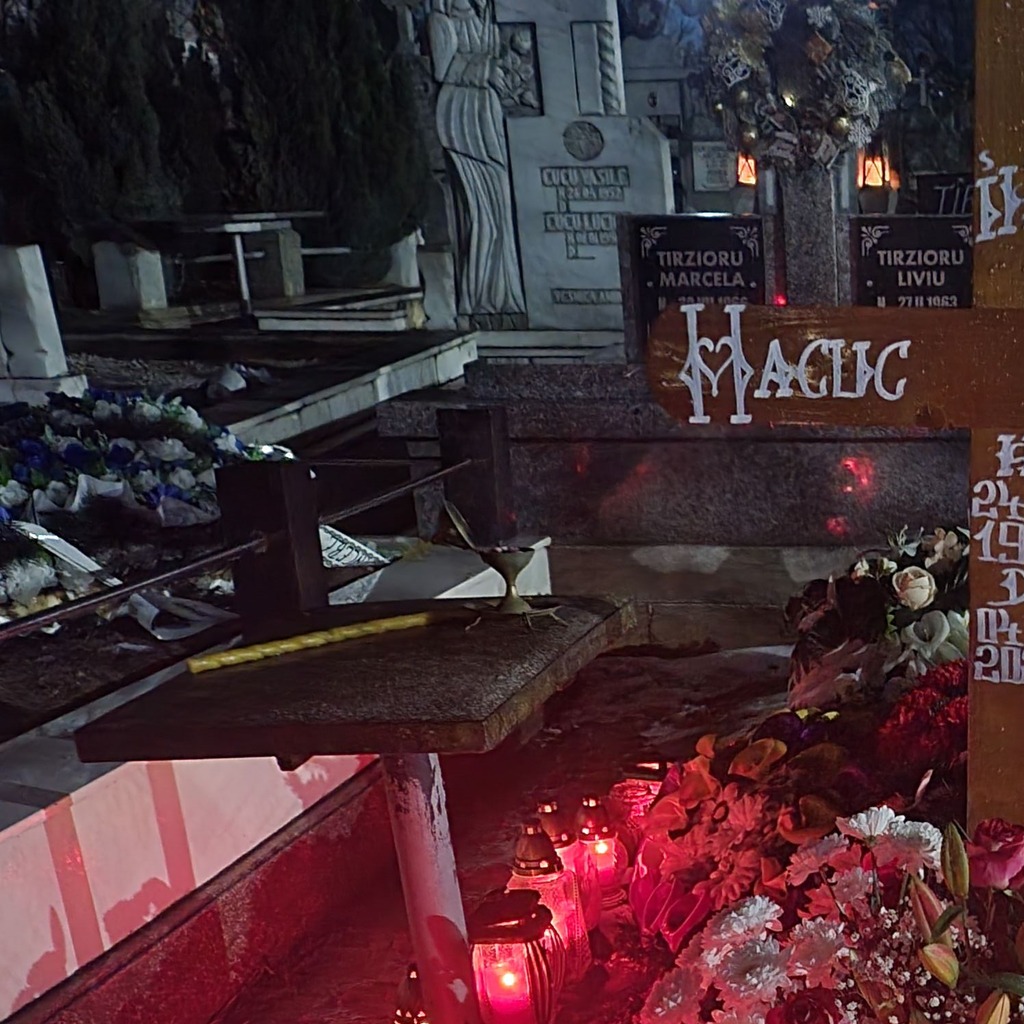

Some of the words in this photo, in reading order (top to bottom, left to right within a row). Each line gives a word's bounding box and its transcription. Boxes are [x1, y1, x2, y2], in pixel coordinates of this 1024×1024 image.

[656, 250, 744, 267] TIRZIORU
[877, 249, 964, 266] TIRZIORU
[659, 271, 746, 288] MARCELA
[898, 271, 945, 287] LIVIU
